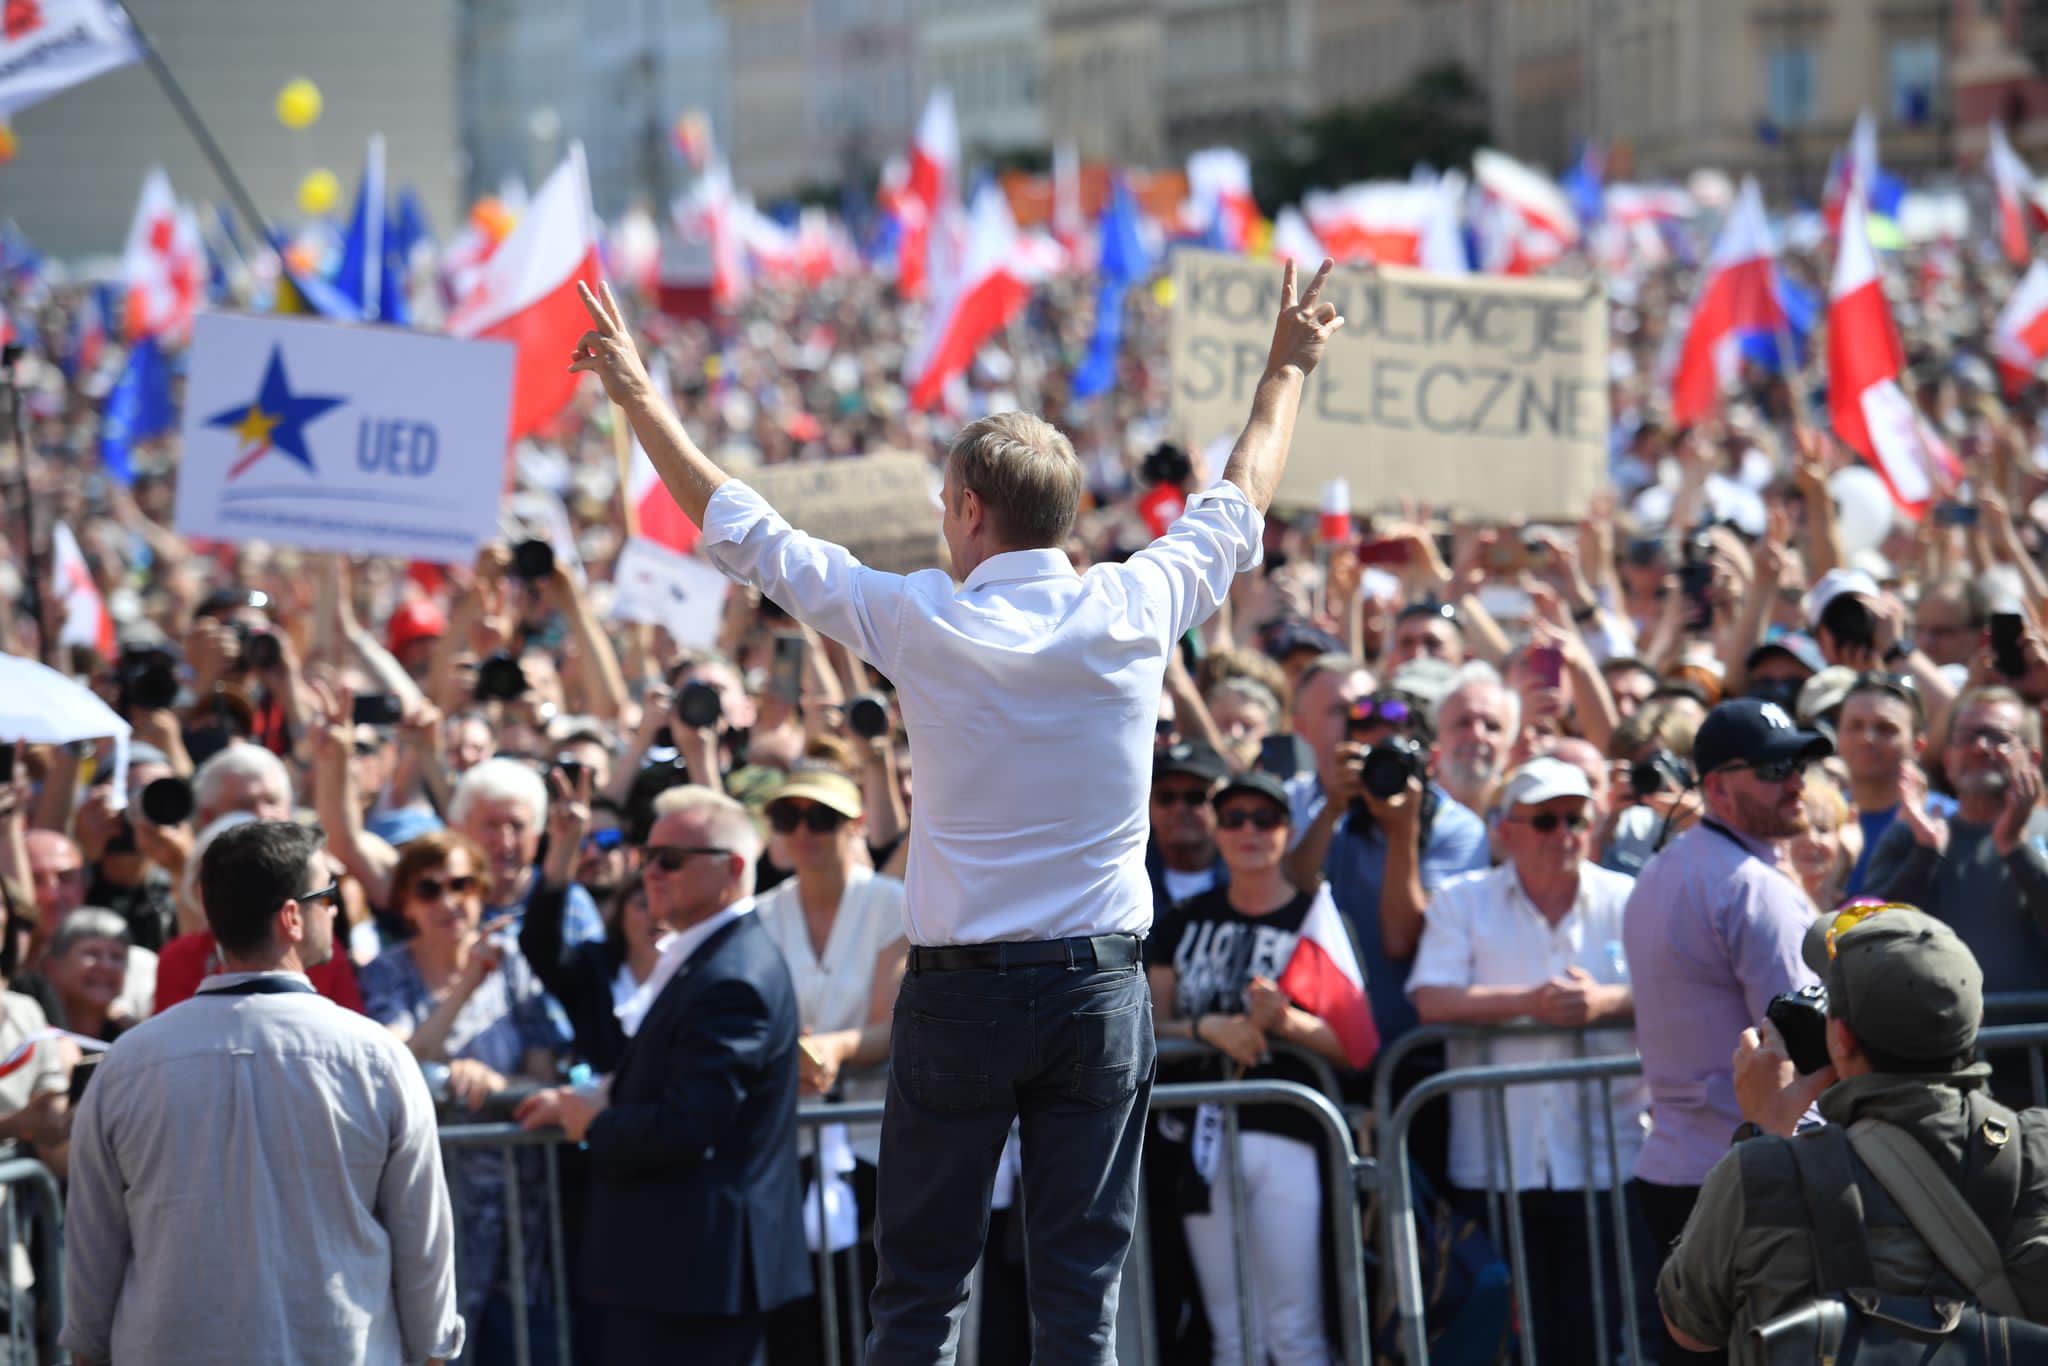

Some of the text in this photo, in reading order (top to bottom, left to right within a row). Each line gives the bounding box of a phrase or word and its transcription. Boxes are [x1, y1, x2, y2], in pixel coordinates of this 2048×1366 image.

[1185, 269, 1588, 365] KONULTACJE
[1181, 336, 1604, 440] SPŁECZNE
[356, 414, 439, 478] UED
